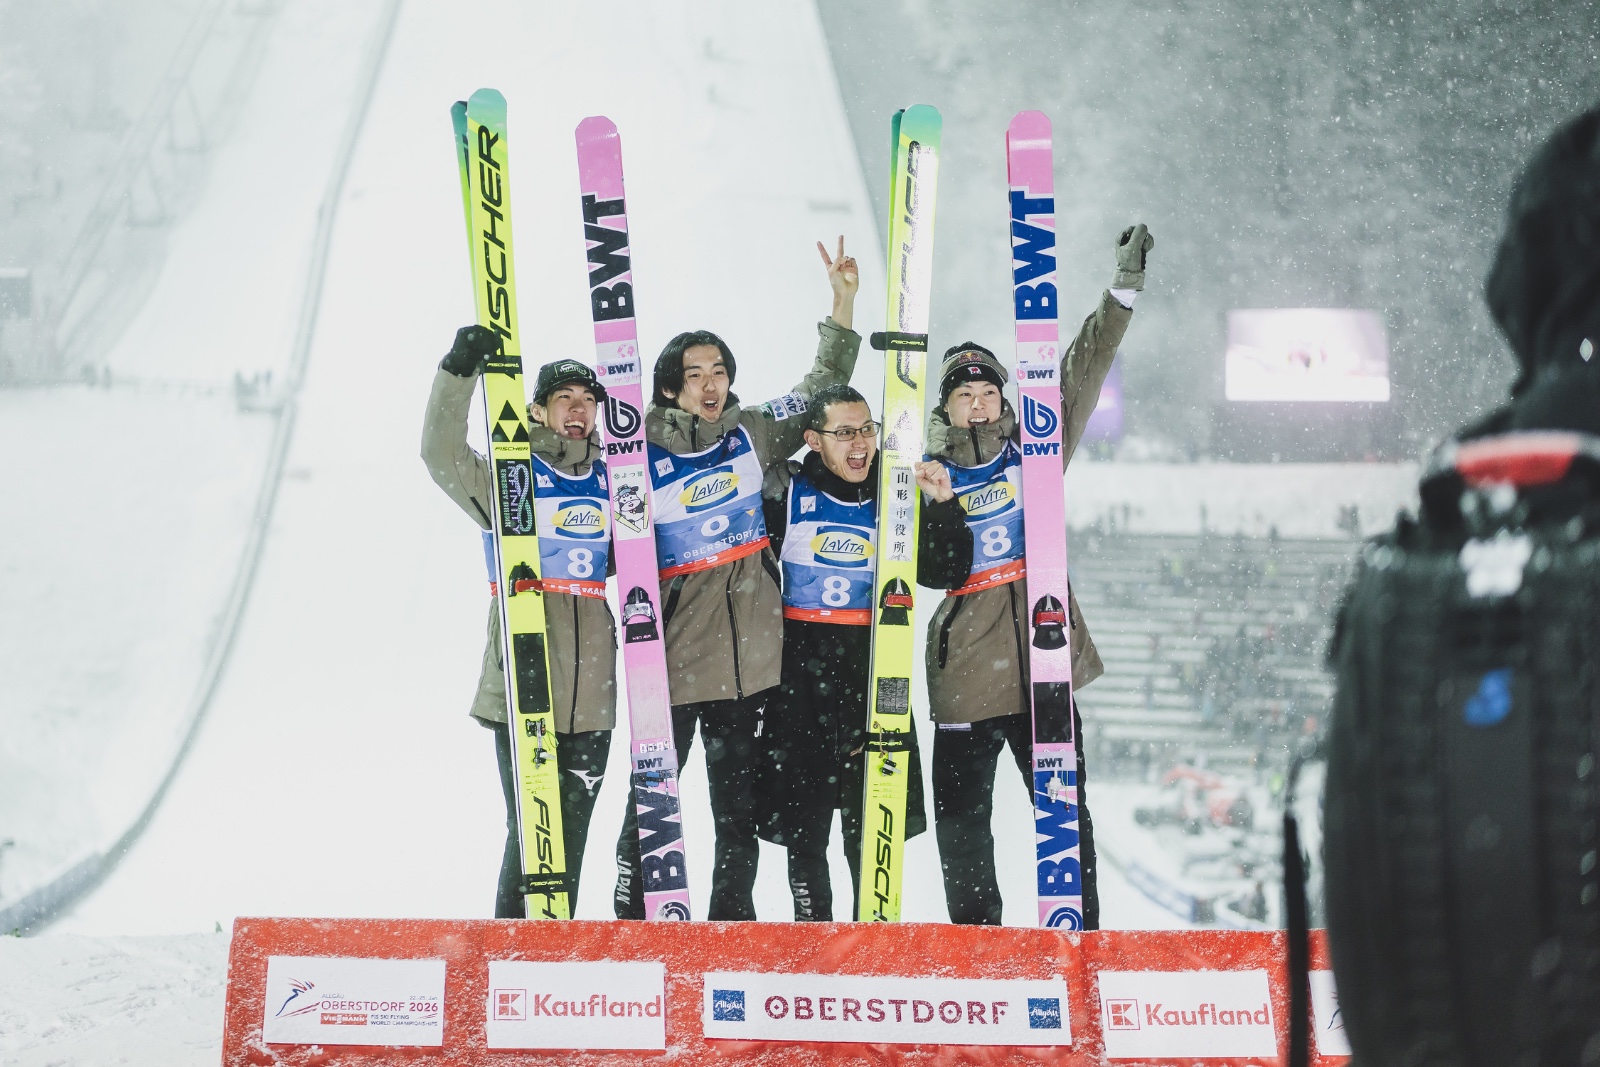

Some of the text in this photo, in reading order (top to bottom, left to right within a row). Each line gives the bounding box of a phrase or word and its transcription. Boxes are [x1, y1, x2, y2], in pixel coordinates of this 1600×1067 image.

[478, 124, 515, 381] ISCHER
[582, 194, 634, 322] BWT
[1011, 190, 1057, 320] BWT
[608, 363, 634, 375] BWT
[1027, 370, 1054, 379] BWT
[607, 440, 643, 455] BWT
[1023, 443, 1059, 455] BWT
[981, 525, 1011, 557] 8
[568, 548, 593, 578] 8
[822, 576, 850, 607] 8
[638, 758, 663, 769] BWT
[1037, 758, 1063, 768] BWT
[616, 855, 632, 905] JAPAN
[321, 1001, 438, 1012] OBERSTDORF 2026
[533, 994, 661, 1017] Kaufland
[765, 995, 1008, 1025] OBERSTDORF
[1145, 1003, 1270, 1025] Kaufland
